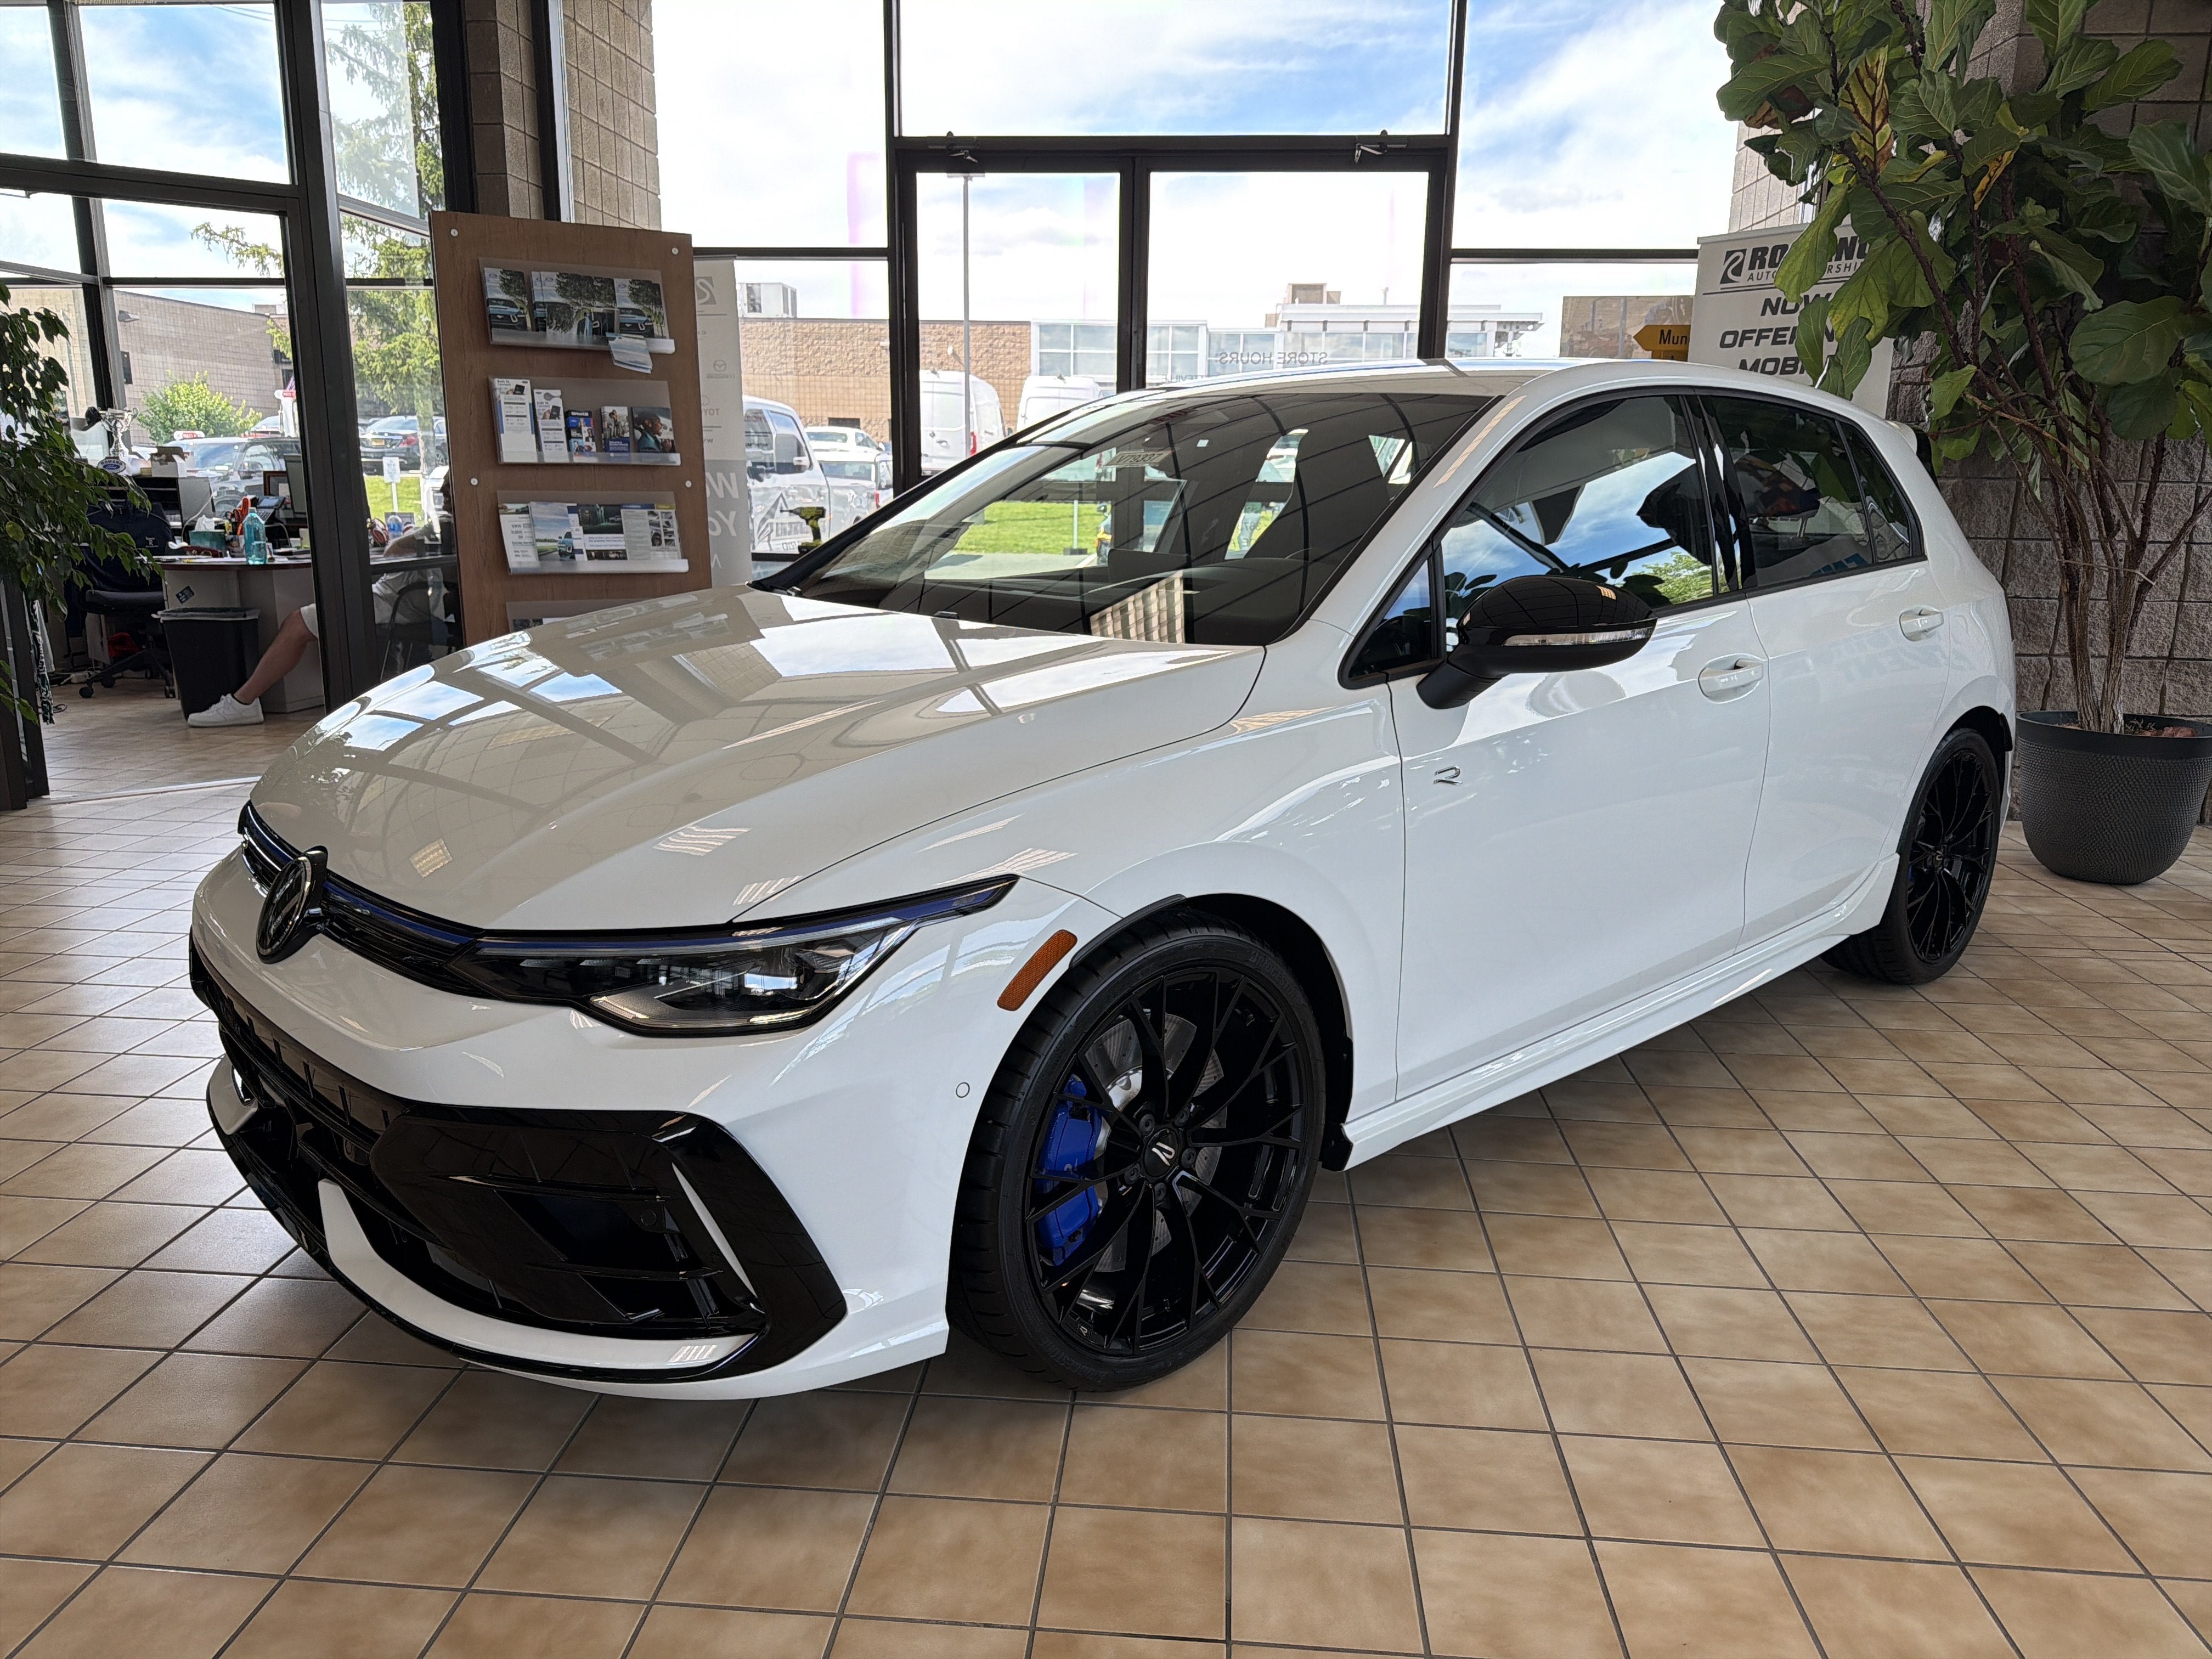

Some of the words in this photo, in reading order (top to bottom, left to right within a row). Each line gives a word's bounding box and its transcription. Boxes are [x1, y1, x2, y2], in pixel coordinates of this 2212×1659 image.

[1748, 236, 1870, 270] RON
[1659, 329, 1687, 345] Mun
[1719, 326, 1835, 348] OFFE
[1739, 357, 1809, 375] MOBI
[1116, 453, 1164, 464] V79337
